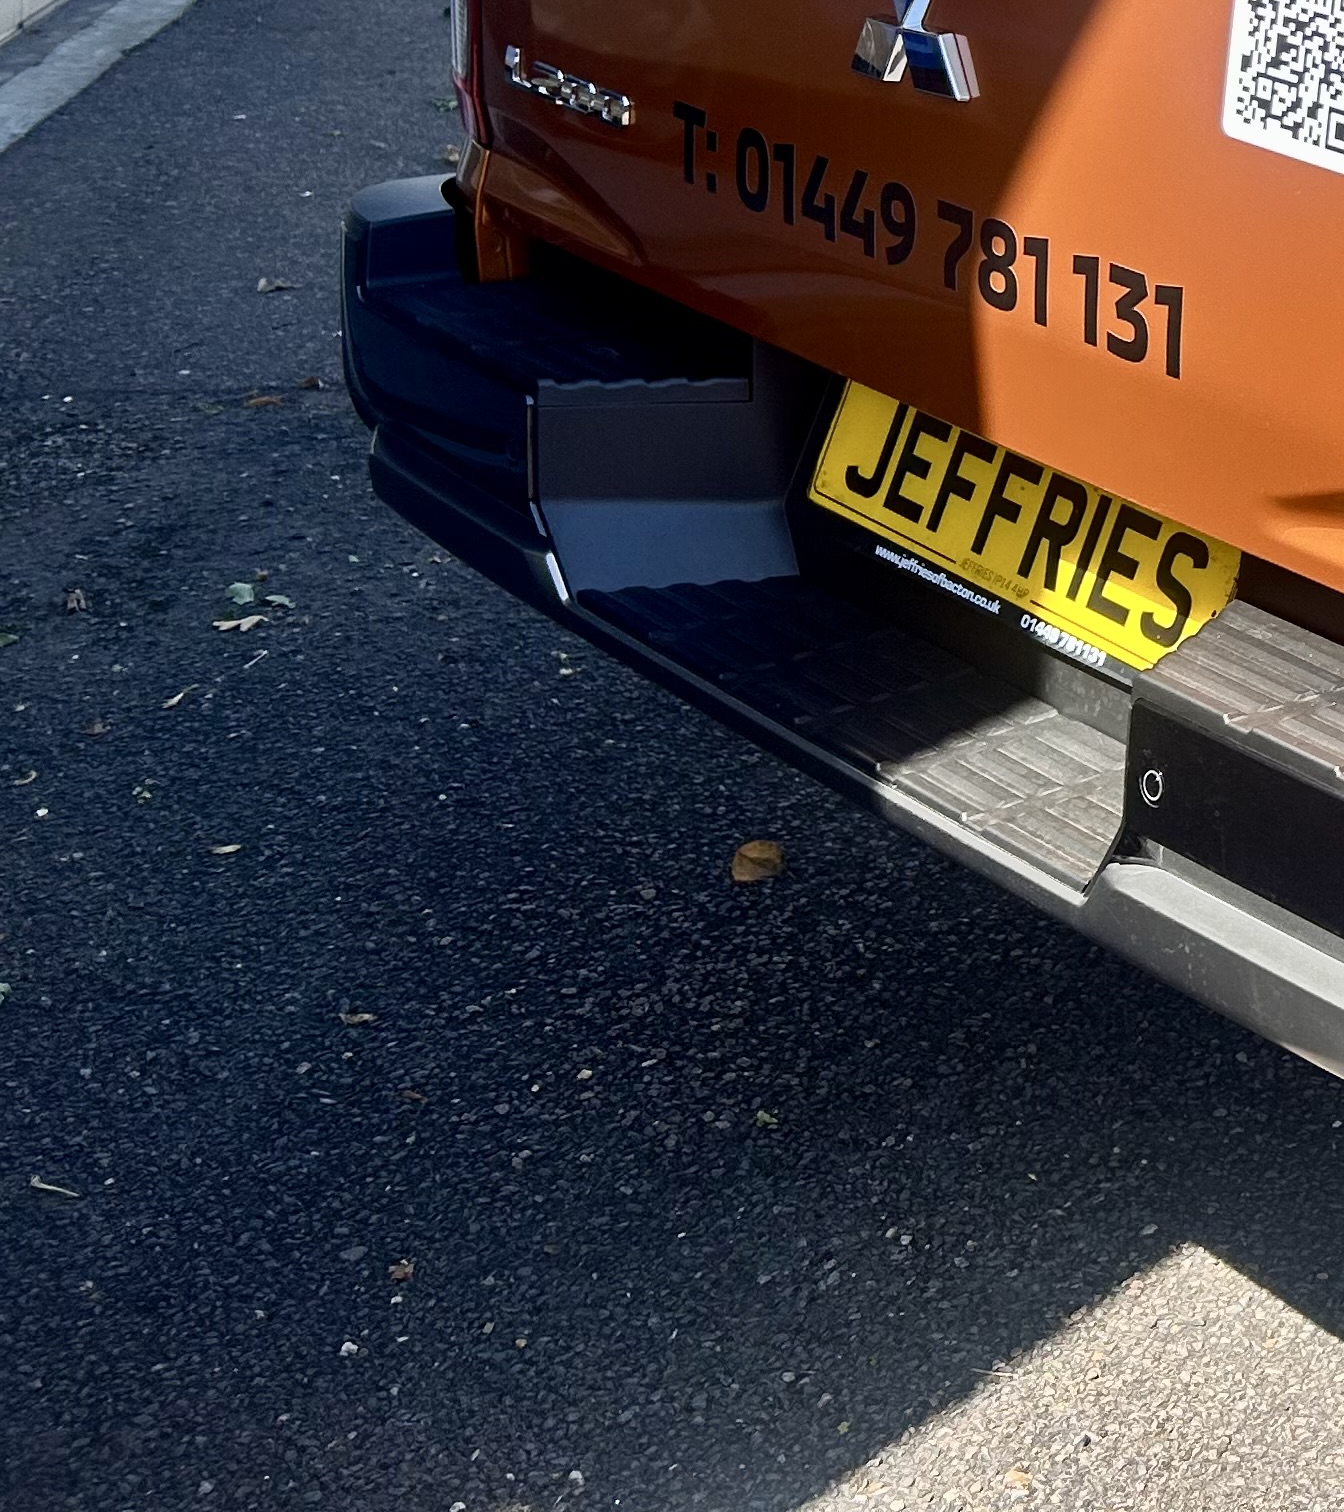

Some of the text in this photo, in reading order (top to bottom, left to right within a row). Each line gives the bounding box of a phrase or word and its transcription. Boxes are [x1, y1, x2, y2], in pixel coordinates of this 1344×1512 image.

[505, 44, 631, 128] L200
[672, 100, 1185, 380] T: 01449 781 131
[845, 403, 1210, 649] JEFFRIES
